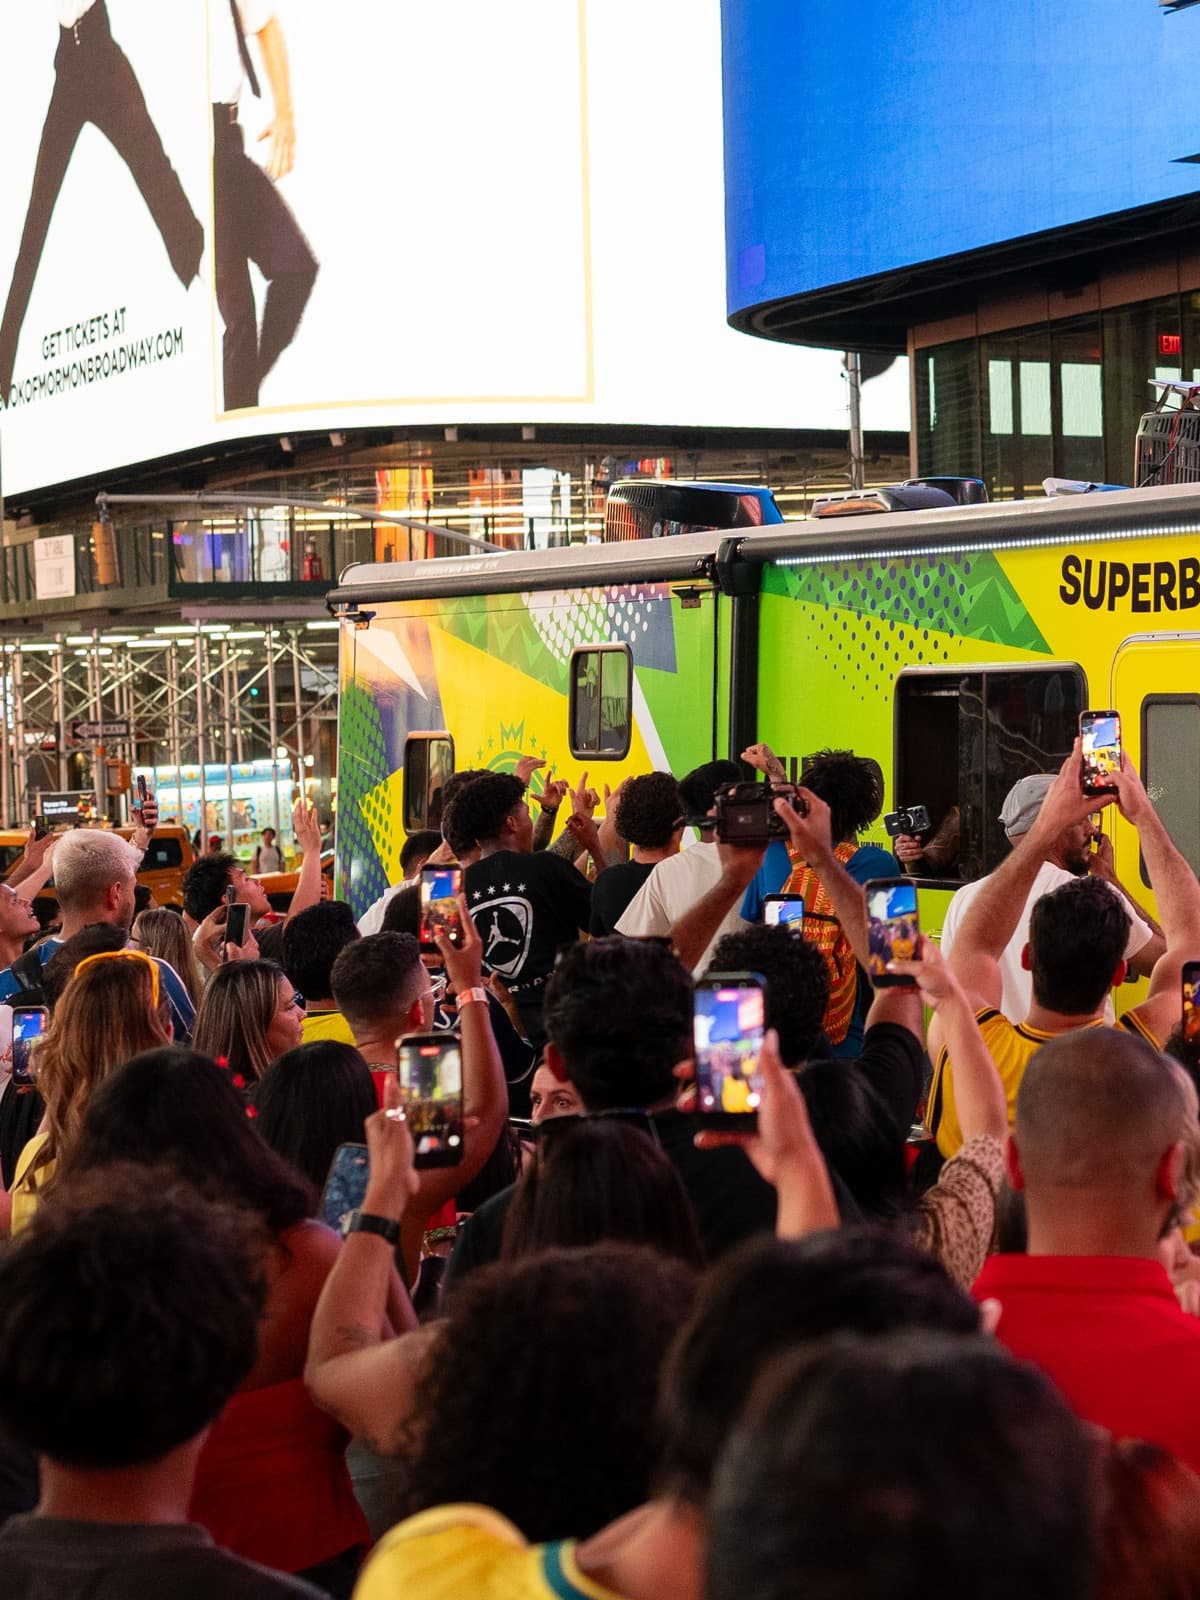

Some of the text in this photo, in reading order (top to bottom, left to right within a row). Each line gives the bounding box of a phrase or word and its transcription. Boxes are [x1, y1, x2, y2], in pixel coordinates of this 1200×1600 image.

[42, 307, 126, 360] GET TICKETS AT
[0, 326, 184, 411] OKOFMORMONBROADWAY.COM
